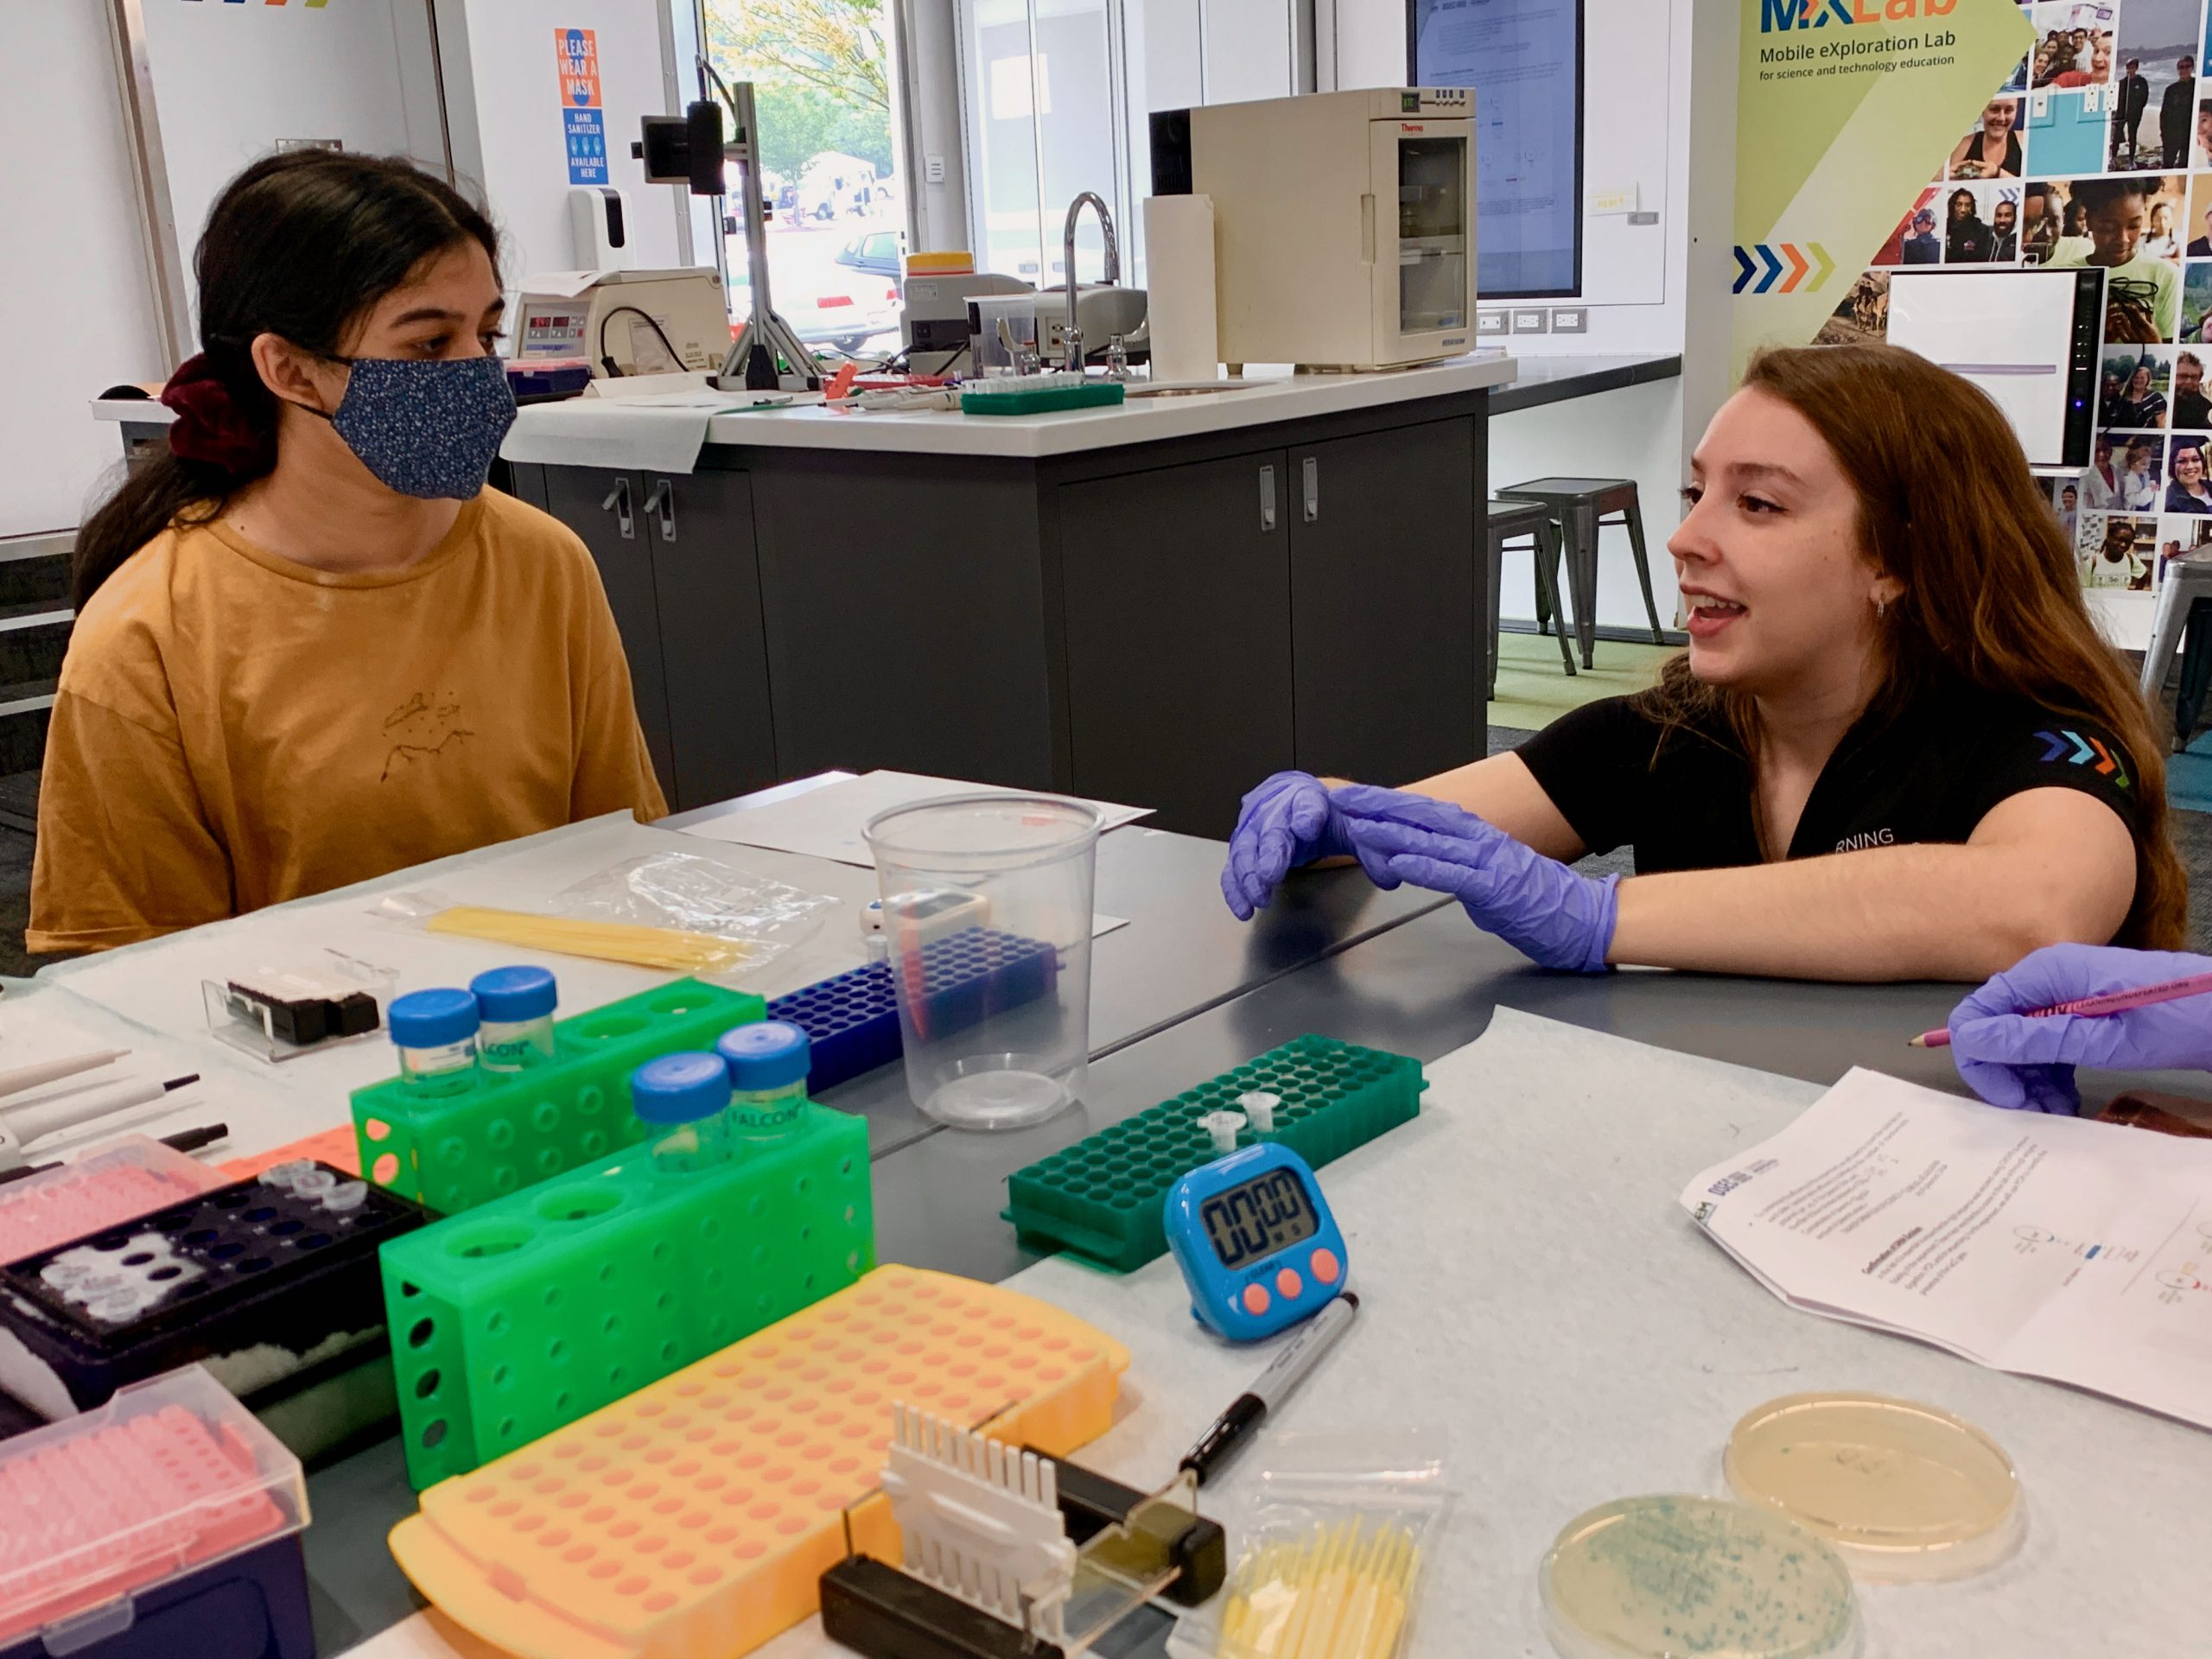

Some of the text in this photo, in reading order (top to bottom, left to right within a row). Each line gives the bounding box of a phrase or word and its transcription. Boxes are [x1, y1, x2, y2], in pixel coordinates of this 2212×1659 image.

[558, 39, 594, 56] PLEASE
[1760, 30, 1956, 63] Mobile eXploration Lab
[559, 59, 598, 76] WEAR A
[1759, 55, 1955, 80] for science and technology education
[566, 79, 594, 95] MASK
[574, 113, 592, 123] HAND
[568, 124, 601, 134] SANITIZER
[571, 157, 604, 167] AVAILABLE
[581, 168, 596, 177] HERE
[1835, 828, 1894, 854] RNING
